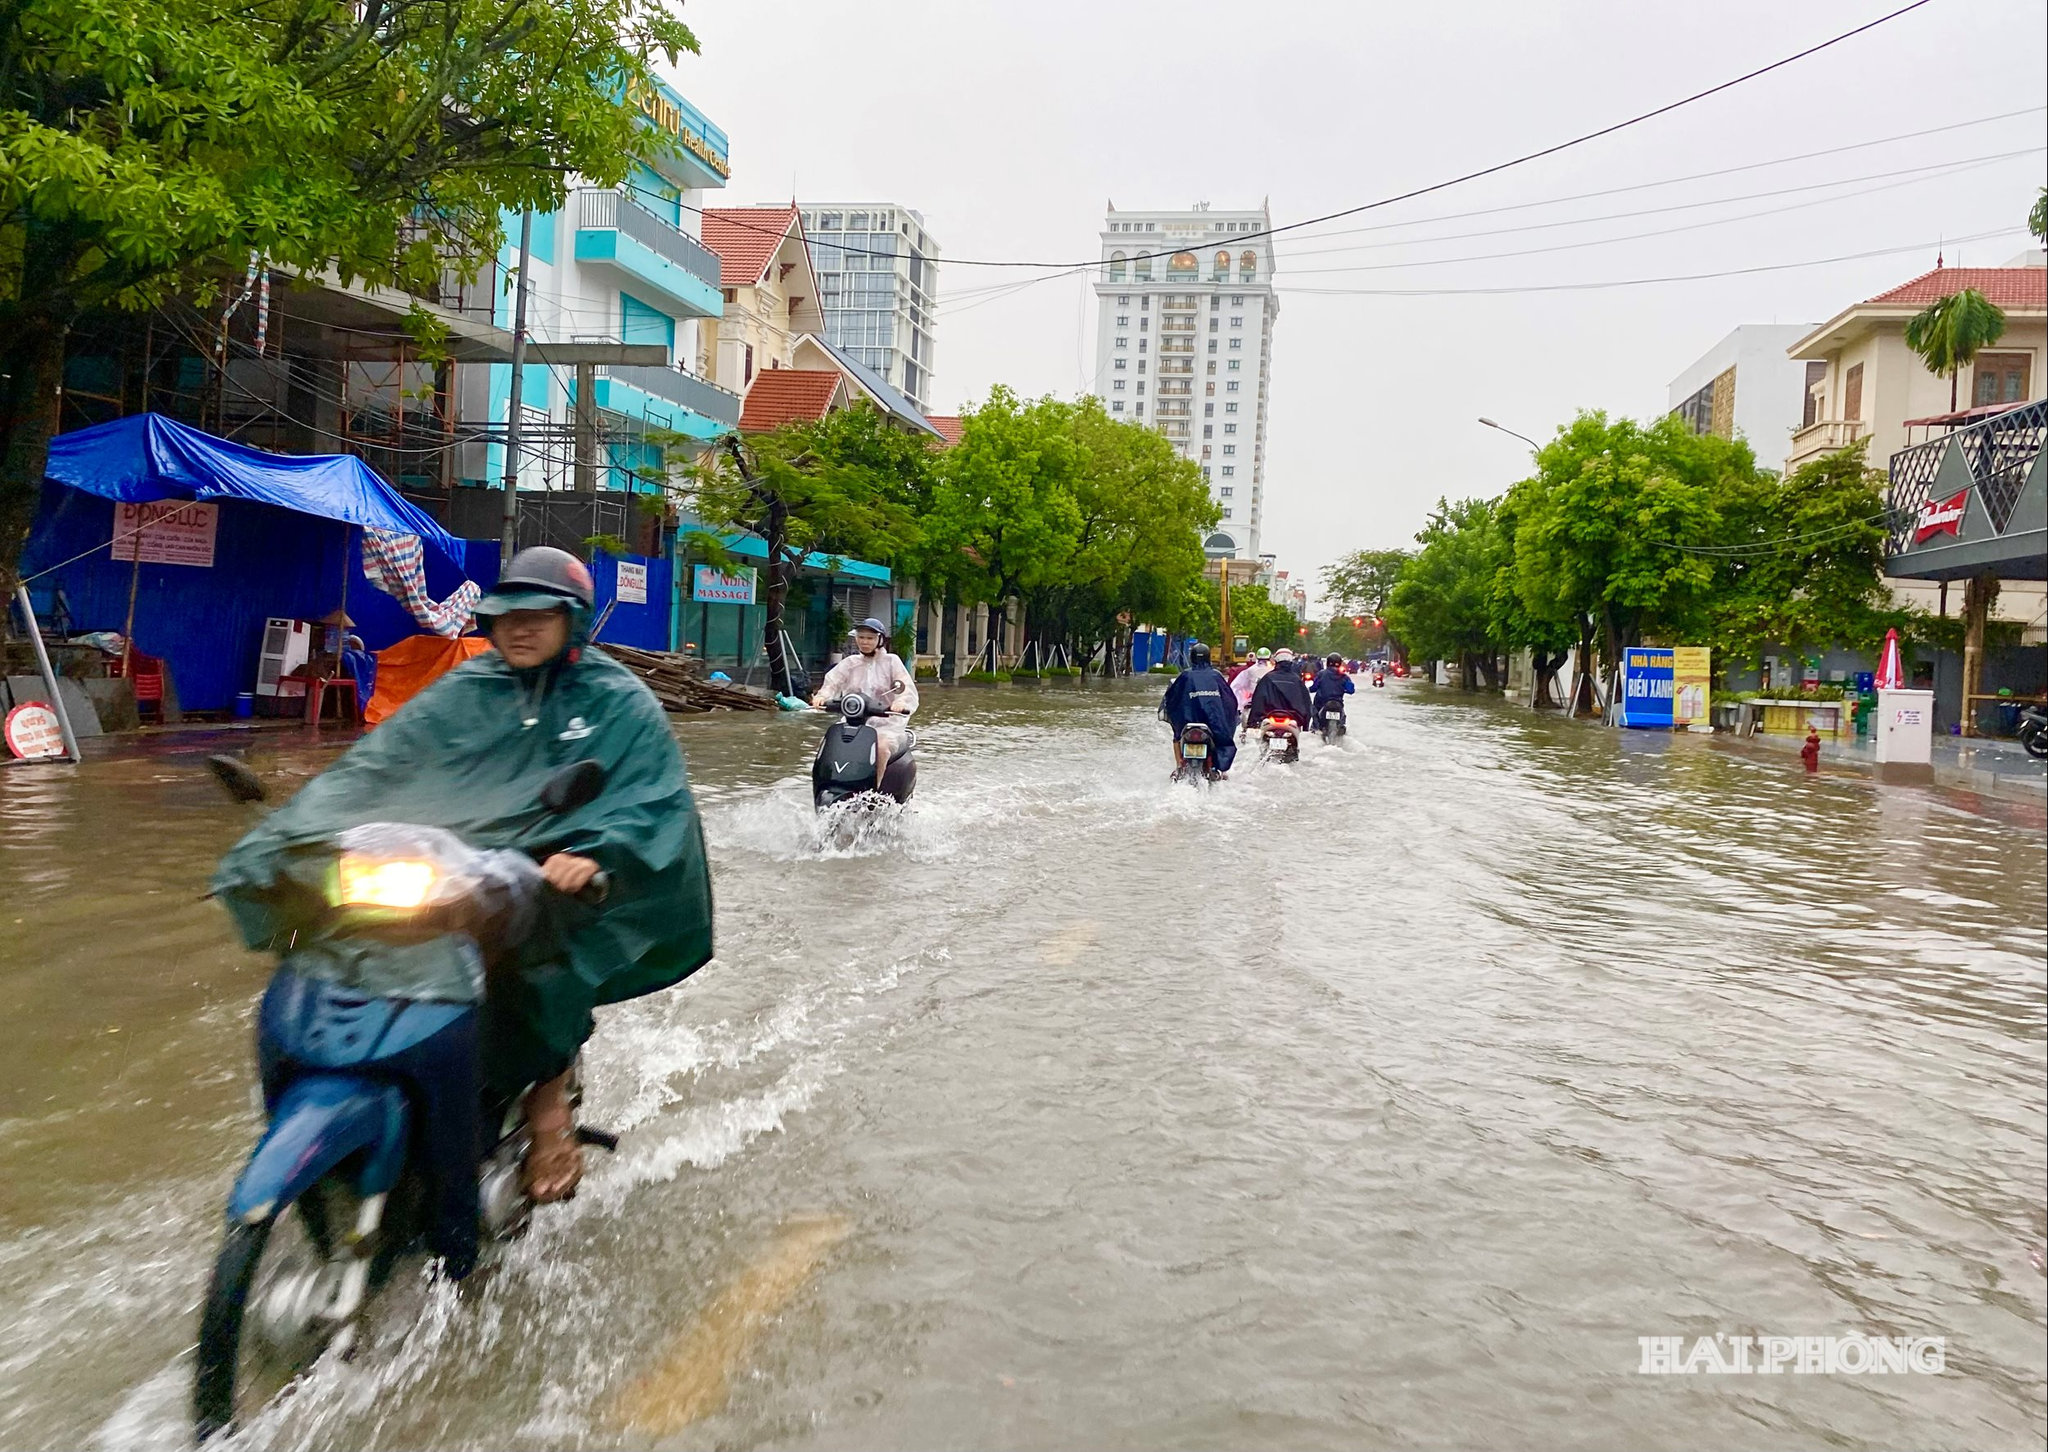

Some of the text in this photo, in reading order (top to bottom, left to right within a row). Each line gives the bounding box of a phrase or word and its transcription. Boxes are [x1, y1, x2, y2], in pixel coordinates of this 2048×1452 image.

[682, 127, 708, 161] Health
[698, 589, 750, 600] MASSAGE
[1630, 653, 1649, 668] NHÀ
[1650, 653, 1674, 669] HÀNG
[1627, 671, 1674, 699] BIỂN XANH
